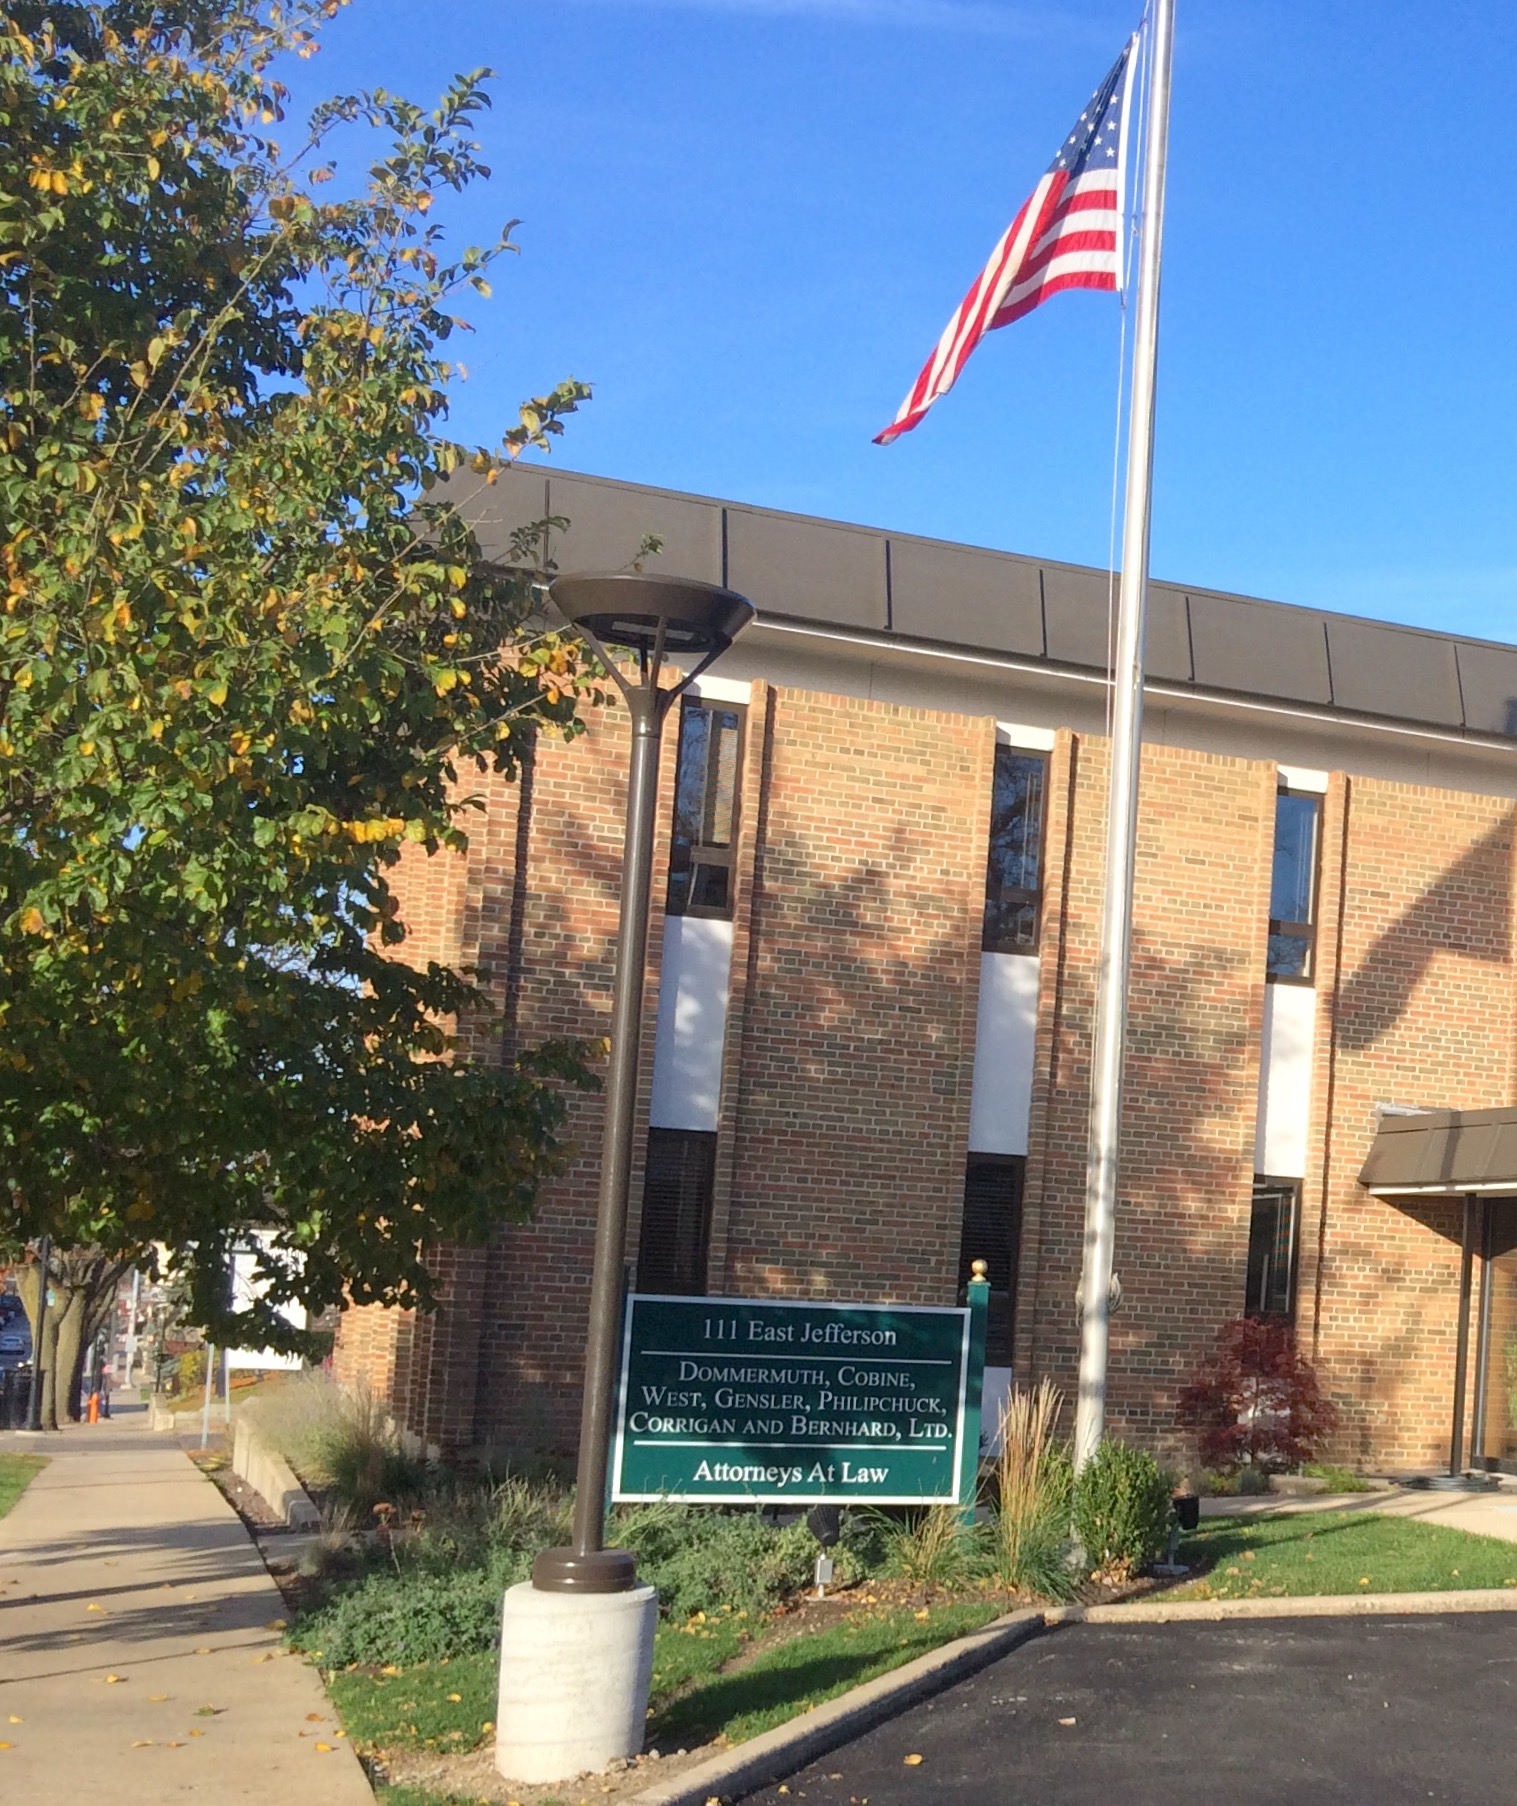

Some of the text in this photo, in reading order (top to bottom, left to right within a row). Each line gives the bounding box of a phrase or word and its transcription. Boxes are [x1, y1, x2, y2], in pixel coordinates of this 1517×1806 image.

[703, 1318, 897, 1346] 111 East Jefferson
[678, 1360, 916, 1391] DOMMERMUTH, COBINE,
[641, 1386, 948, 1416] WEST, GENSLER, PHILIPCHUCK,
[629, 1412, 953, 1441] CORRIGAN AND BERNHARD, LTD.
[692, 1460, 889, 1487] Attorneys At Law
